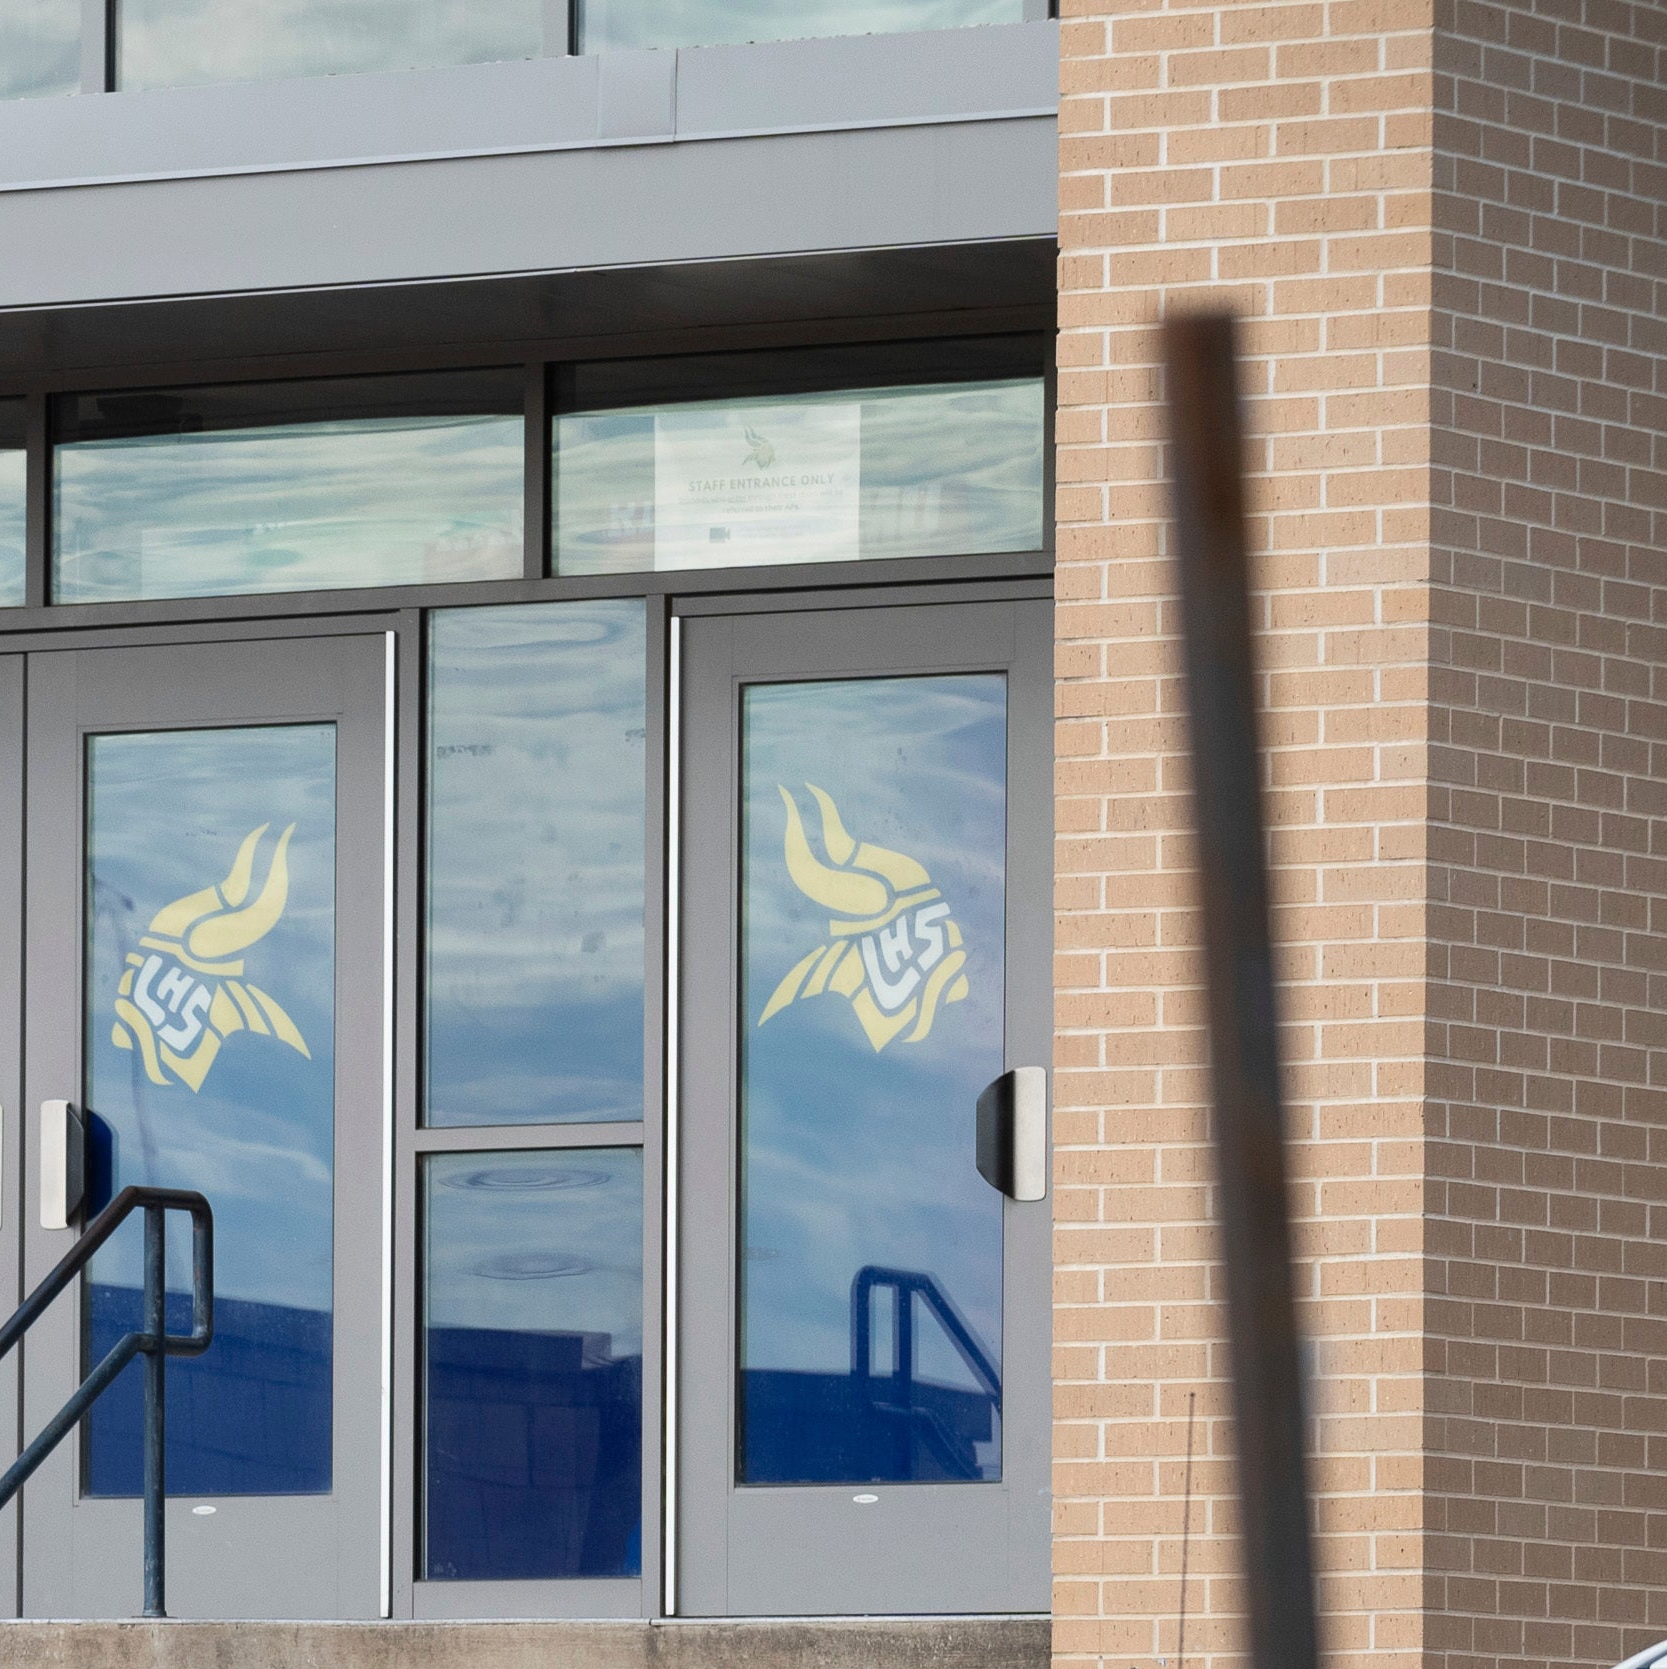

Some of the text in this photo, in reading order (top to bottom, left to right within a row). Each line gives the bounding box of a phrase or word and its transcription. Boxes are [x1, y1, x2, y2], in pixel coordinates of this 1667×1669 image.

[688, 473, 835, 492] STAFF ENTRANCE ONLY
[134, 954, 212, 1052] LHS
[861, 901, 951, 1010] LHS
